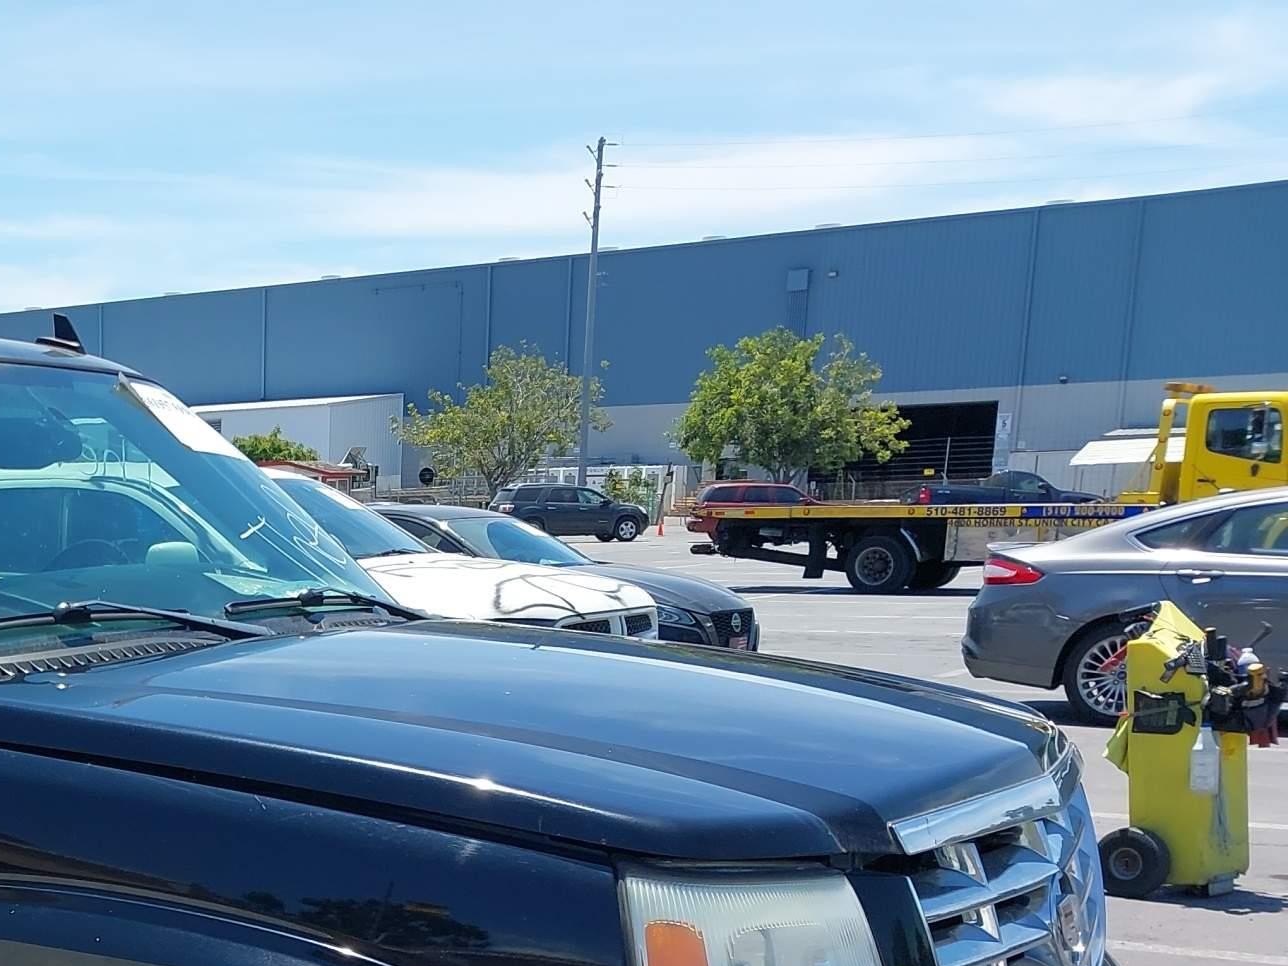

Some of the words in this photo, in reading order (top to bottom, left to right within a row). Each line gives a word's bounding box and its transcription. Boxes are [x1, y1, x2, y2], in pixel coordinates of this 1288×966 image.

[925, 506, 1007, 517] 510-481-8869
[974, 518, 1016, 528] HORNER
[1071, 518, 1097, 528] CITY
